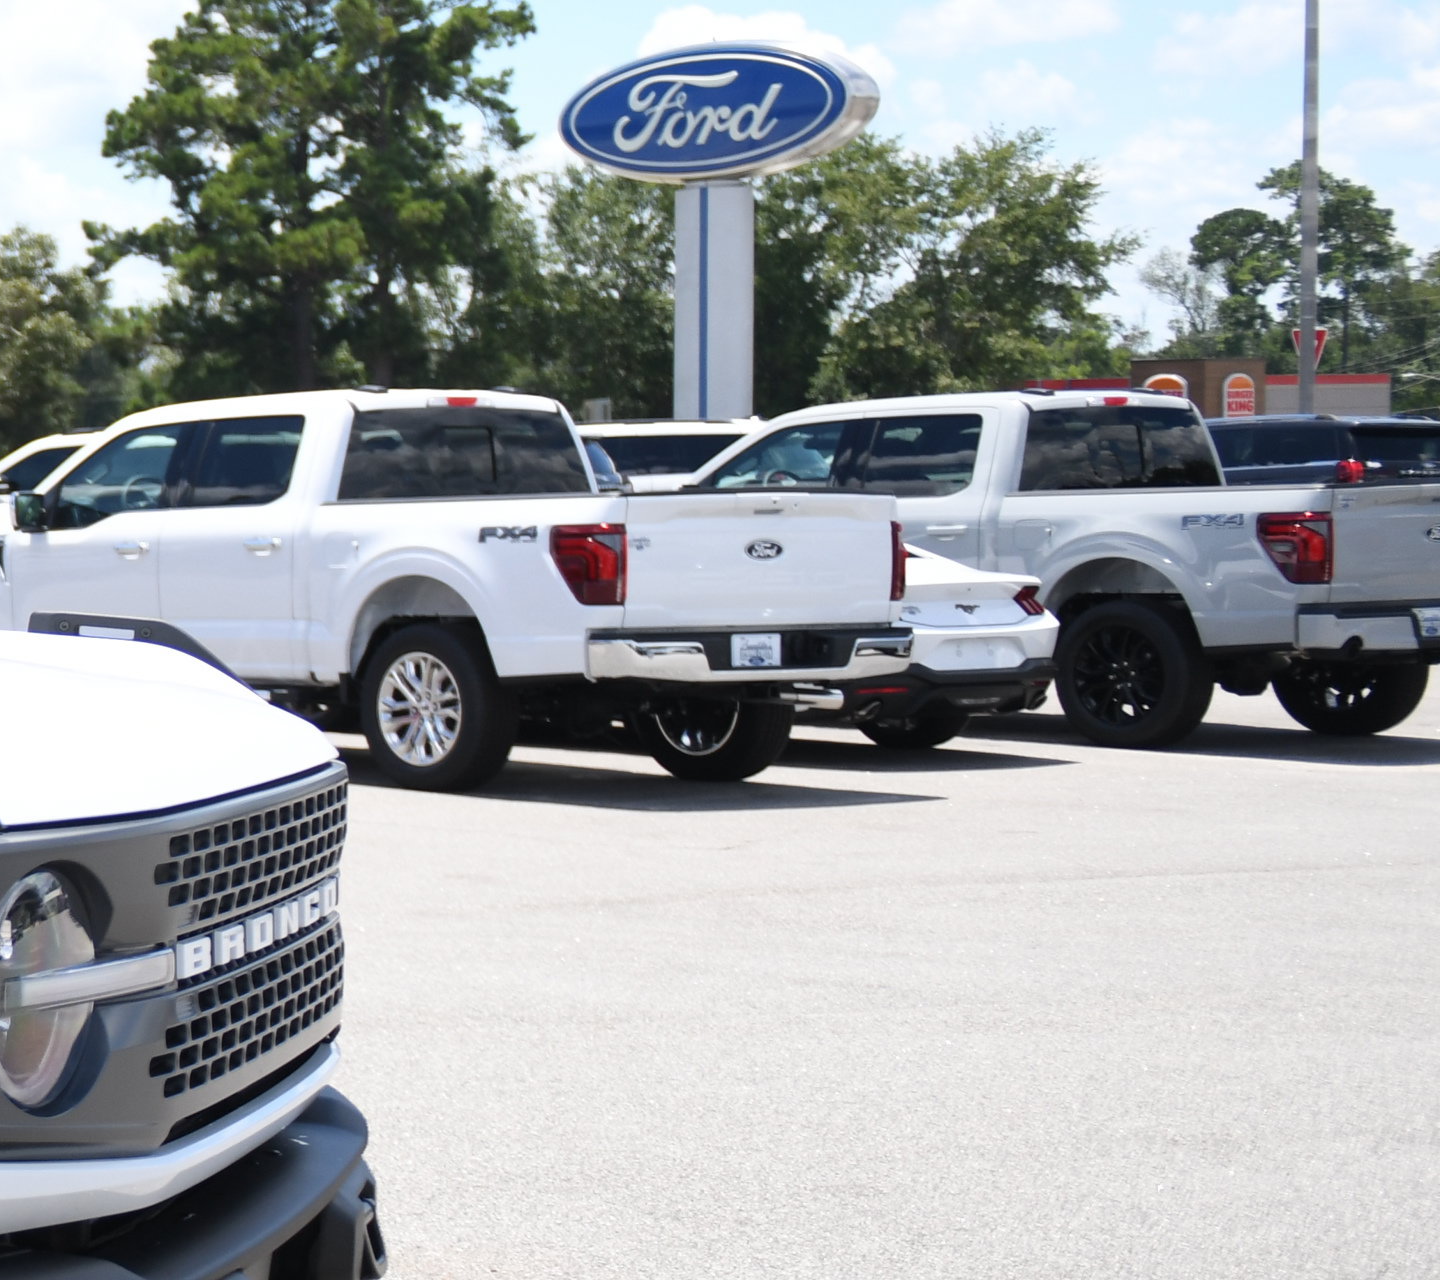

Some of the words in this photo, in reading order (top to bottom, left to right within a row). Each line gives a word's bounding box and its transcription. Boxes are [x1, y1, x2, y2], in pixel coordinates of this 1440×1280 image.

[613, 70, 783, 152] Ford
[1227, 400, 1254, 412] KING
[1181, 513, 1244, 531] FX4
[478, 525, 538, 543] FX4
[176, 875, 339, 980] BRONCO
